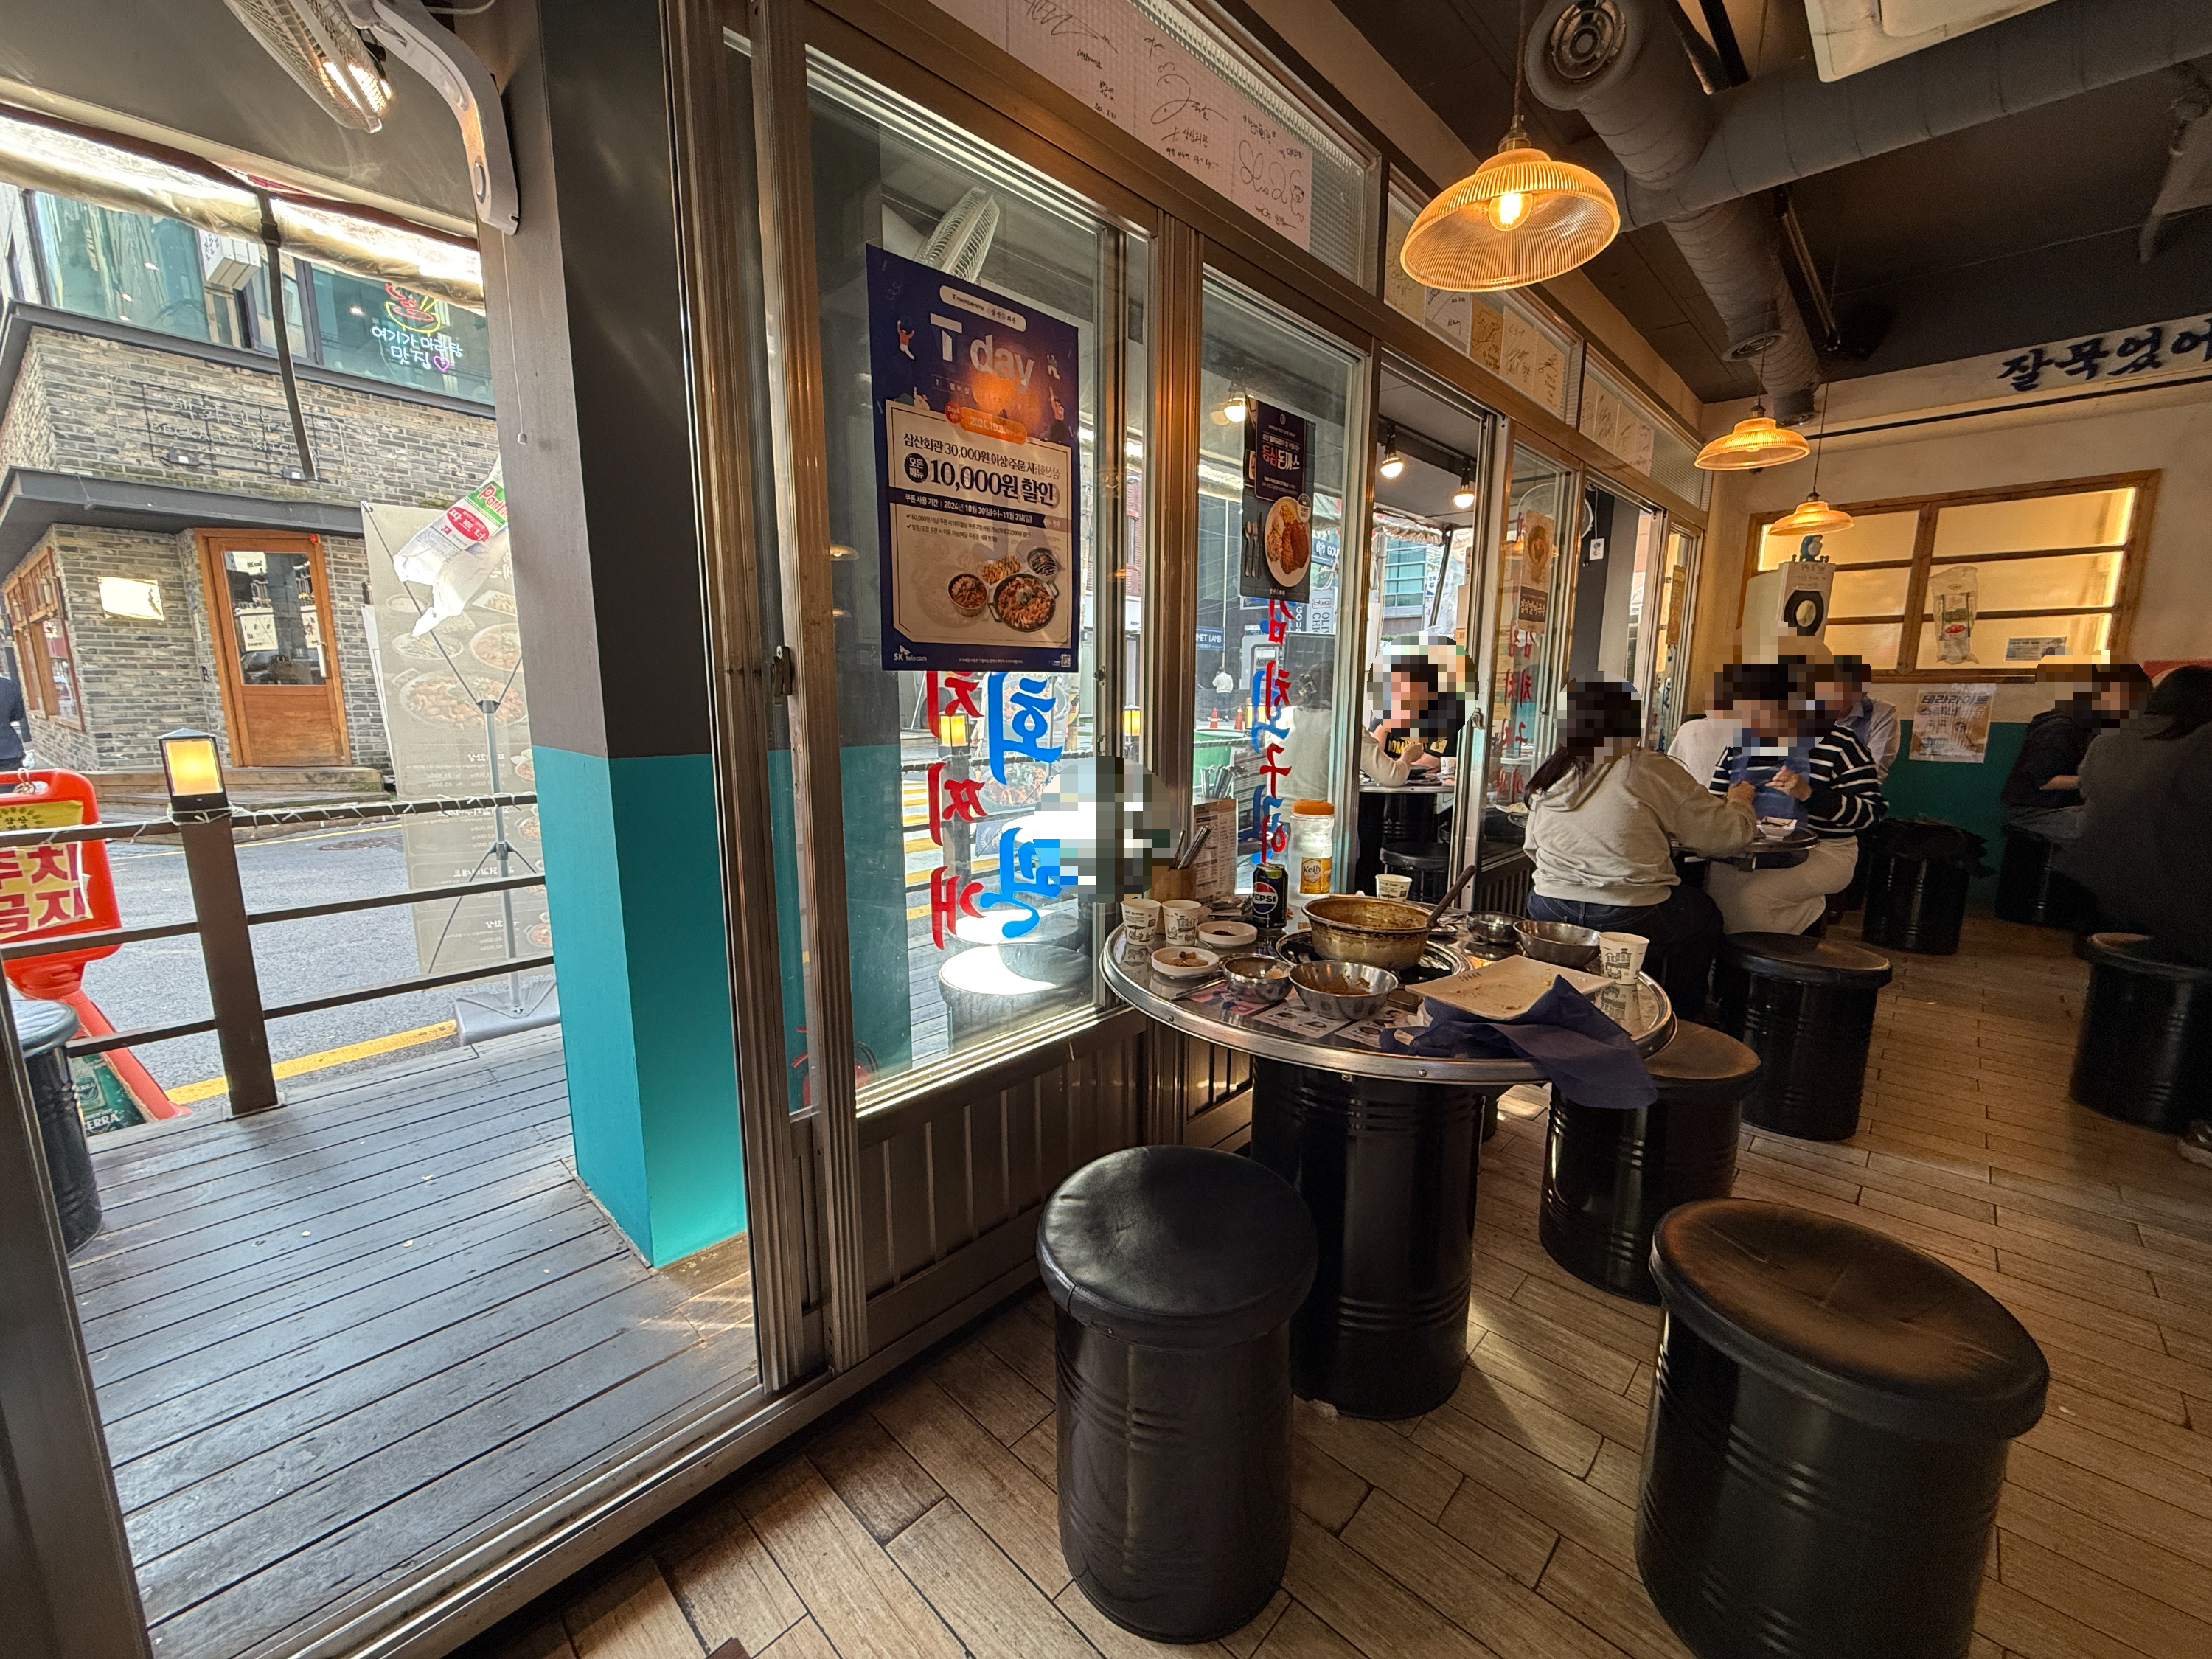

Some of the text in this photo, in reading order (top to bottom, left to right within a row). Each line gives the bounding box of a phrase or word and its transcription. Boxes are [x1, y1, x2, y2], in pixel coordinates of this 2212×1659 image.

[371, 325, 464, 358] 여기가 마라탕
[390, 344, 431, 369] 맛집
[930, 313, 1034, 395] T day
[903, 433, 944, 454] 삼산회관
[945, 444, 990, 465] 30,000원
[991, 453, 1008, 469] 이상
[1009, 456, 1026, 473] 주문
[907, 456, 925, 470] 모든
[1262, 443, 1300, 471] 등심돈까스
[908, 467, 925, 481] 메뉴
[930, 459, 1054, 508] 10,000원 할인
[905, 494, 917, 503] 쿠폰
[917, 495, 928, 506] 사용
[928, 497, 939, 507] 기간
[944, 500, 964, 512] 2024년
[965, 504, 978, 514] 10월
[448, 509, 488, 543] 파트너
[1312, 612, 1321, 633] CHI
[1321, 611, 1331, 633] OLI
[894, 653, 904, 661] SK
[1304, 865, 1321, 875] Kelly
